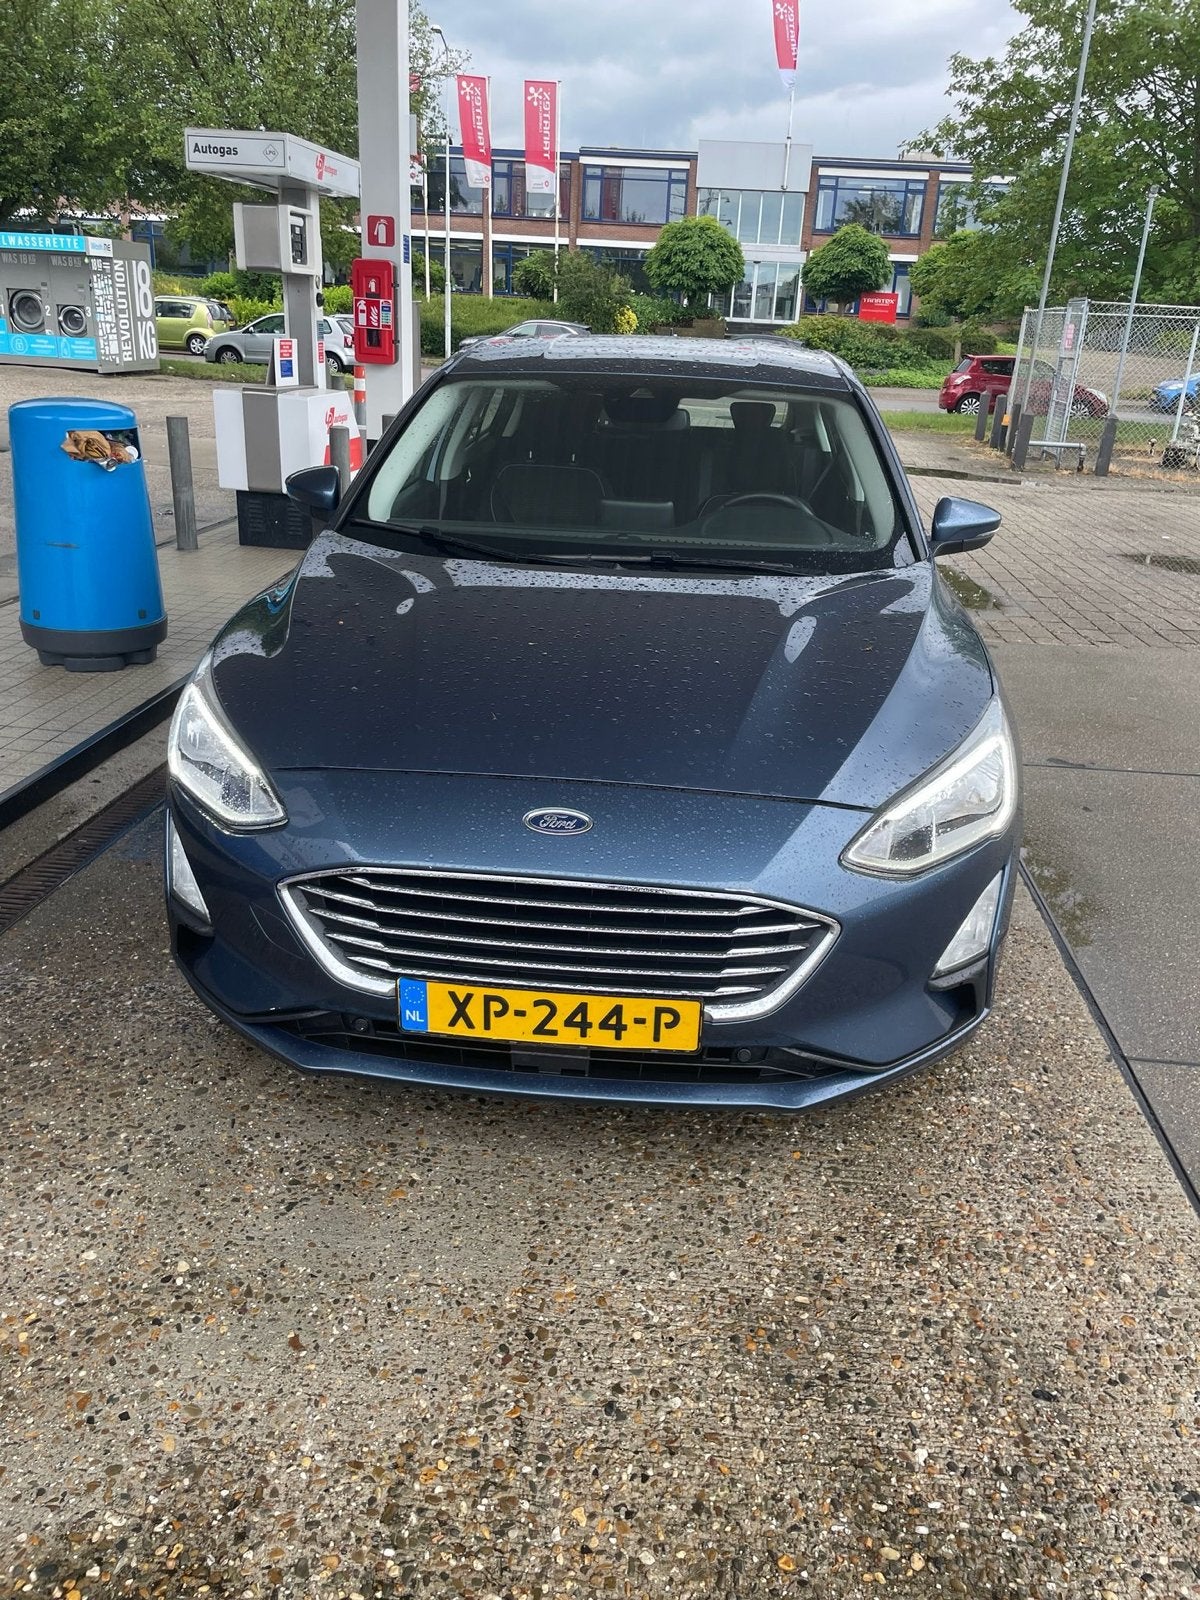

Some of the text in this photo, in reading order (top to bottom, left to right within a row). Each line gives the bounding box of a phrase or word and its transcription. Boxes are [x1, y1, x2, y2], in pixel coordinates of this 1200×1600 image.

[193, 142, 239, 157] Autogas
[1, 252, 18, 264] WAS
[50, 255, 67, 267] WAS
[132, 260, 153, 318] 18
[45, 305, 51, 316] 2
[85, 306, 91, 317] 3
[113, 259, 133, 362] REVOLUTION
[137, 320, 157, 360] KG
[539, 814, 578, 829] Ford
[405, 1009, 424, 1023] NL
[447, 990, 681, 1043] XP-244-P
